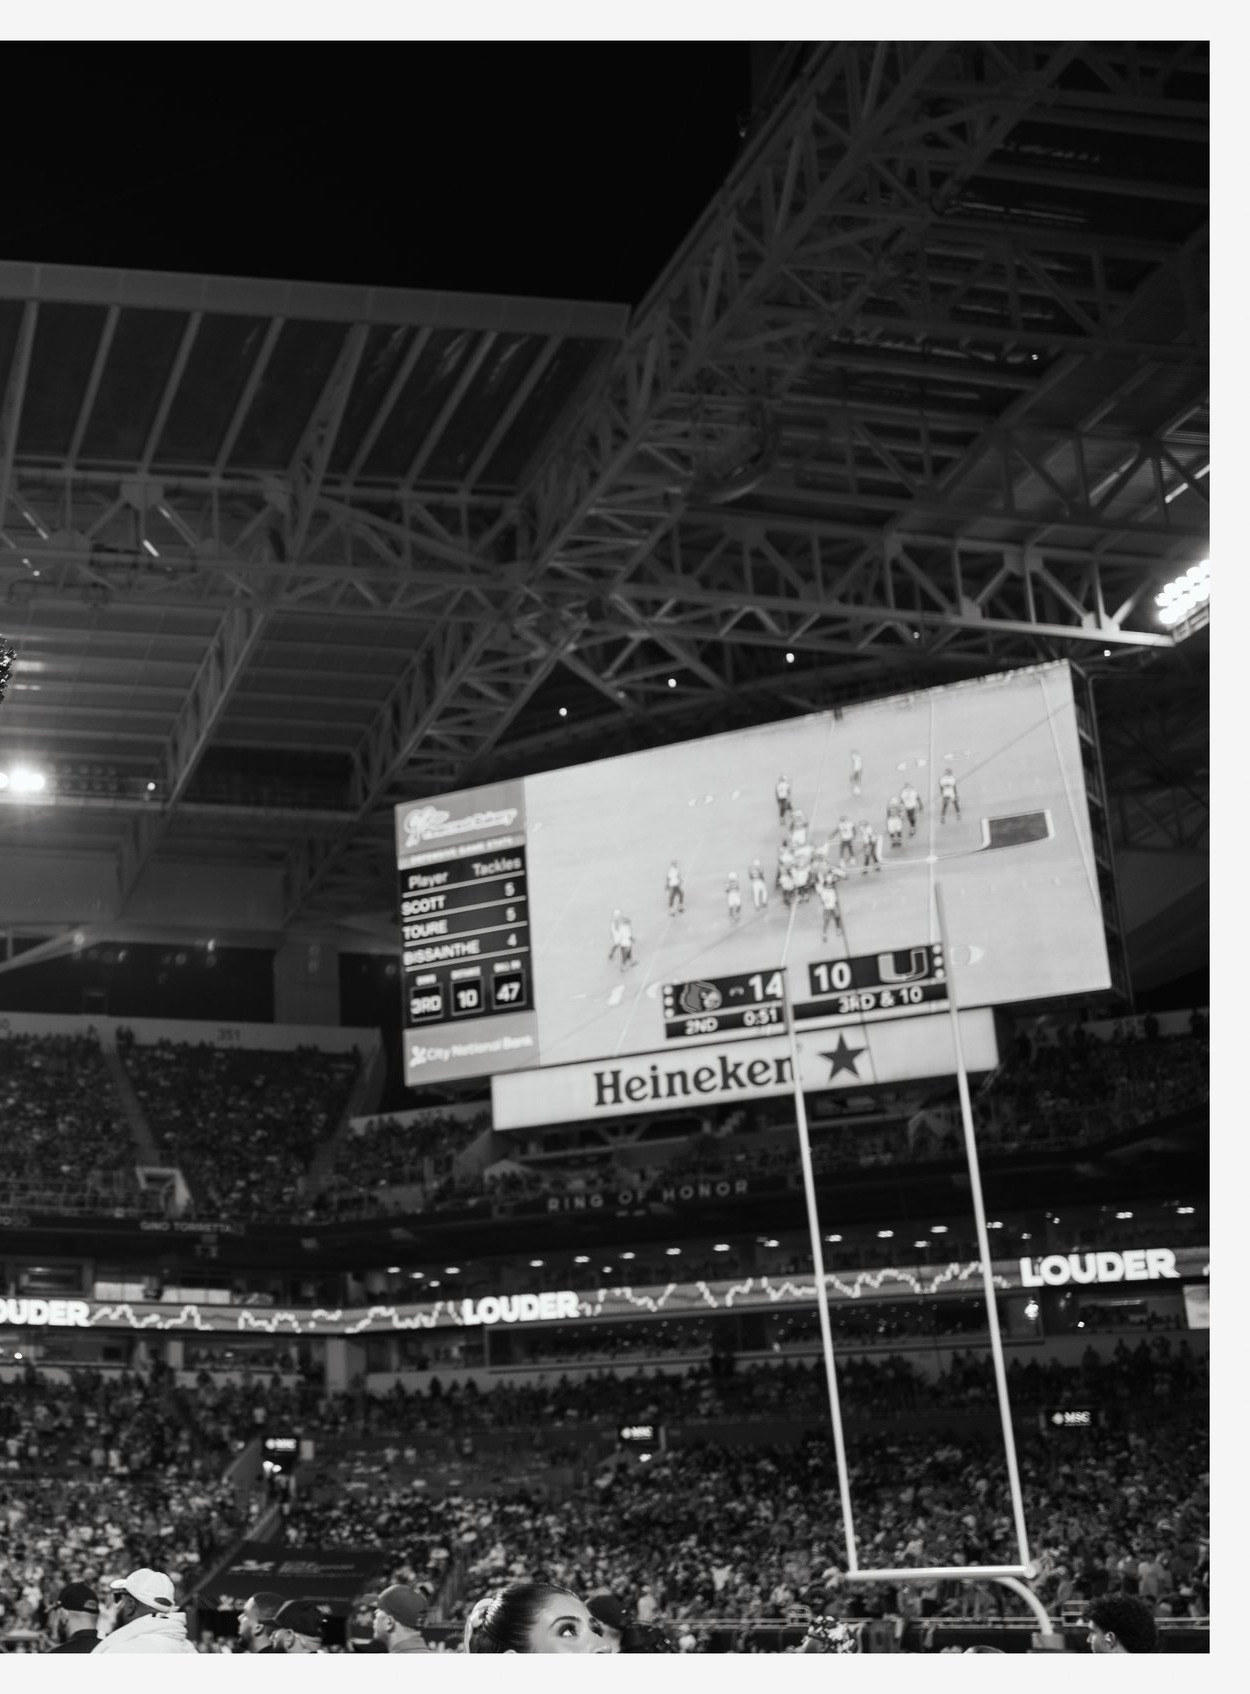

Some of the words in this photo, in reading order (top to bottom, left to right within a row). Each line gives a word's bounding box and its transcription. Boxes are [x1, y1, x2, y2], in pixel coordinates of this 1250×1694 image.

[408, 871, 449, 890] Player
[472, 856, 522, 877] Tackles
[401, 894, 446, 916] SCOTT
[504, 881, 515, 897] 5
[402, 919, 448, 940] TOURE
[505, 906, 516, 922] 5
[403, 939, 480, 966] BISSAINTHE
[507, 933, 517, 947] 4
[496, 981, 521, 1002] 47
[748, 971, 783, 1002] 14
[813, 961, 852, 992] 10
[410, 994, 442, 1015] 3RD
[456, 988, 479, 1009] 10
[838, 992, 876, 1014] 3RD
[879, 990, 895, 1008] &
[899, 985, 923, 1005] 10
[685, 1016, 719, 1035] 2ND
[743, 1007, 778, 1027] 0:51
[594, 1052, 803, 1107] Heineken
[547, 1193, 604, 1212] RING
[617, 1188, 647, 1206] OF
[662, 1178, 750, 1203] HONOR
[1019, 1248, 1181, 1288] LOUDER
[461, 1290, 579, 1325] LOUDER
